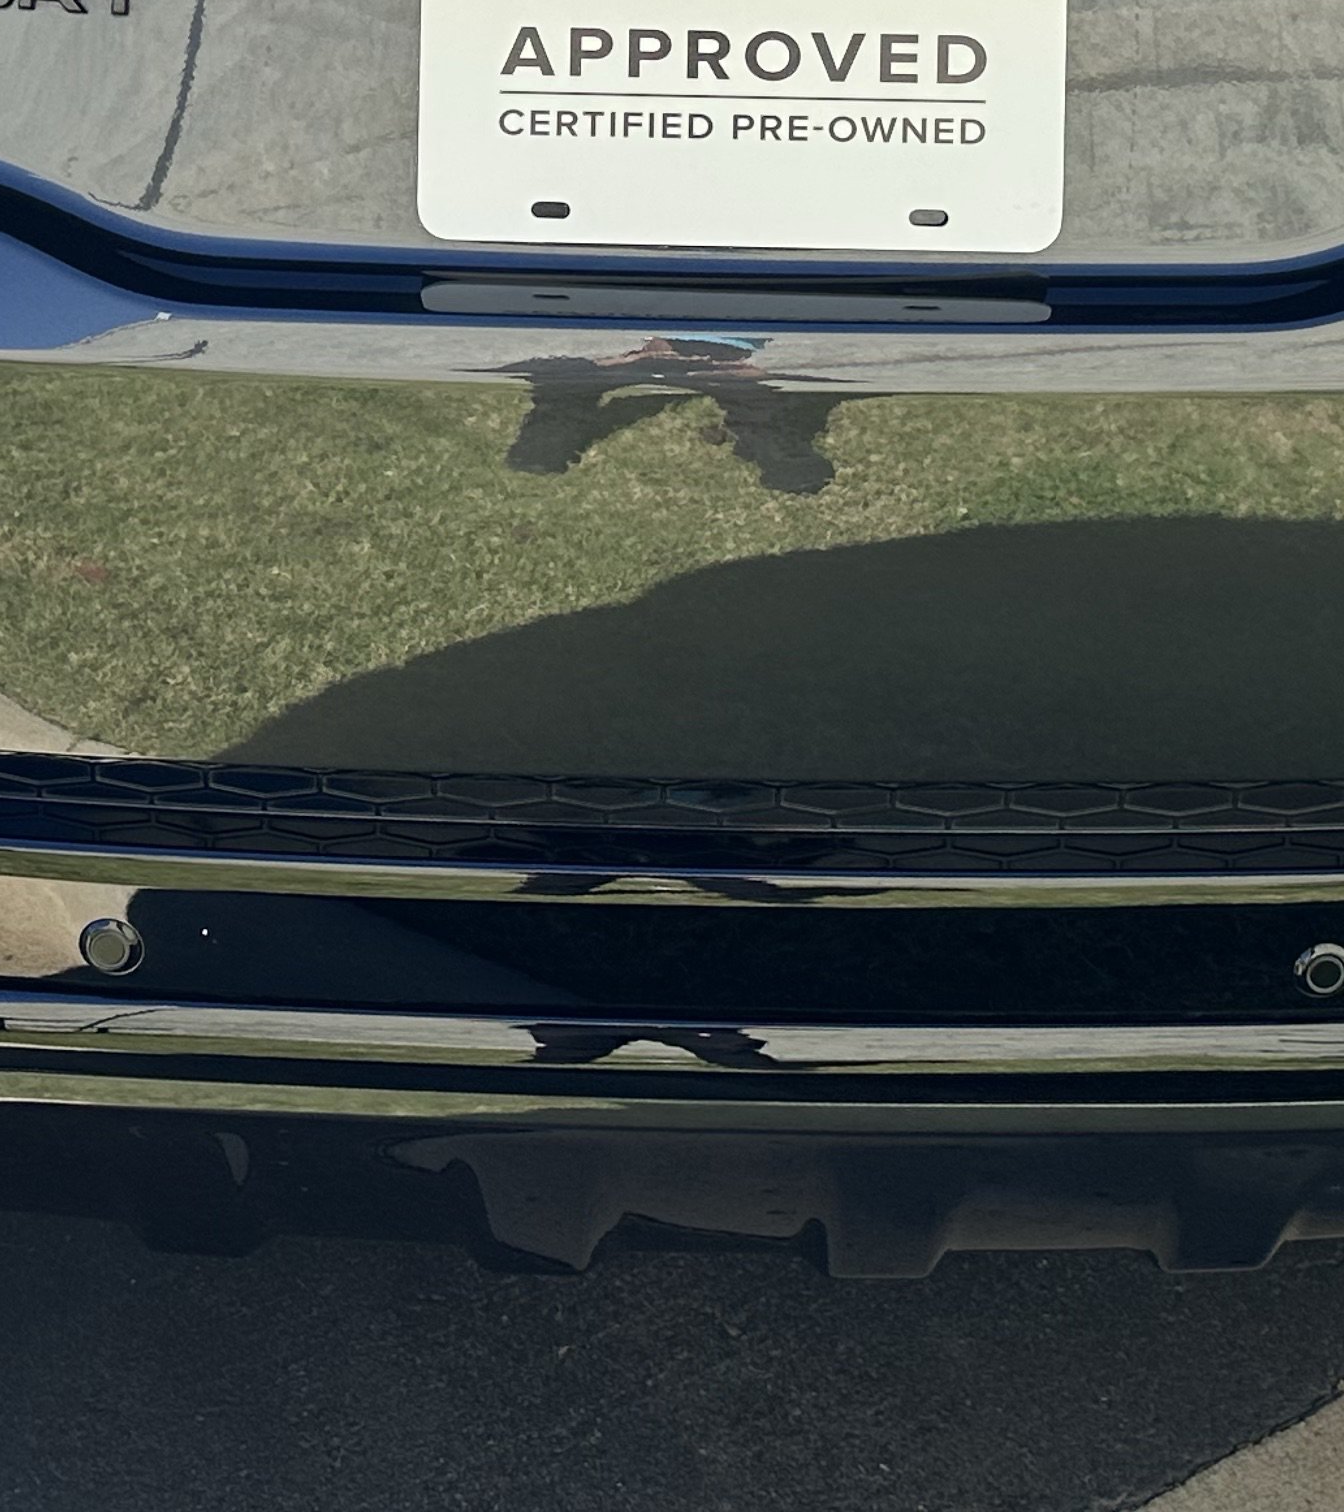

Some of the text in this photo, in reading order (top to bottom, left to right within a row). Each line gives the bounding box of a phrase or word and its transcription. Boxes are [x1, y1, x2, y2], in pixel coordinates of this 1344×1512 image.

[500, 25, 988, 85] APPROVED
[498, 108, 987, 145] CERTIFIED PRE-OWNED
